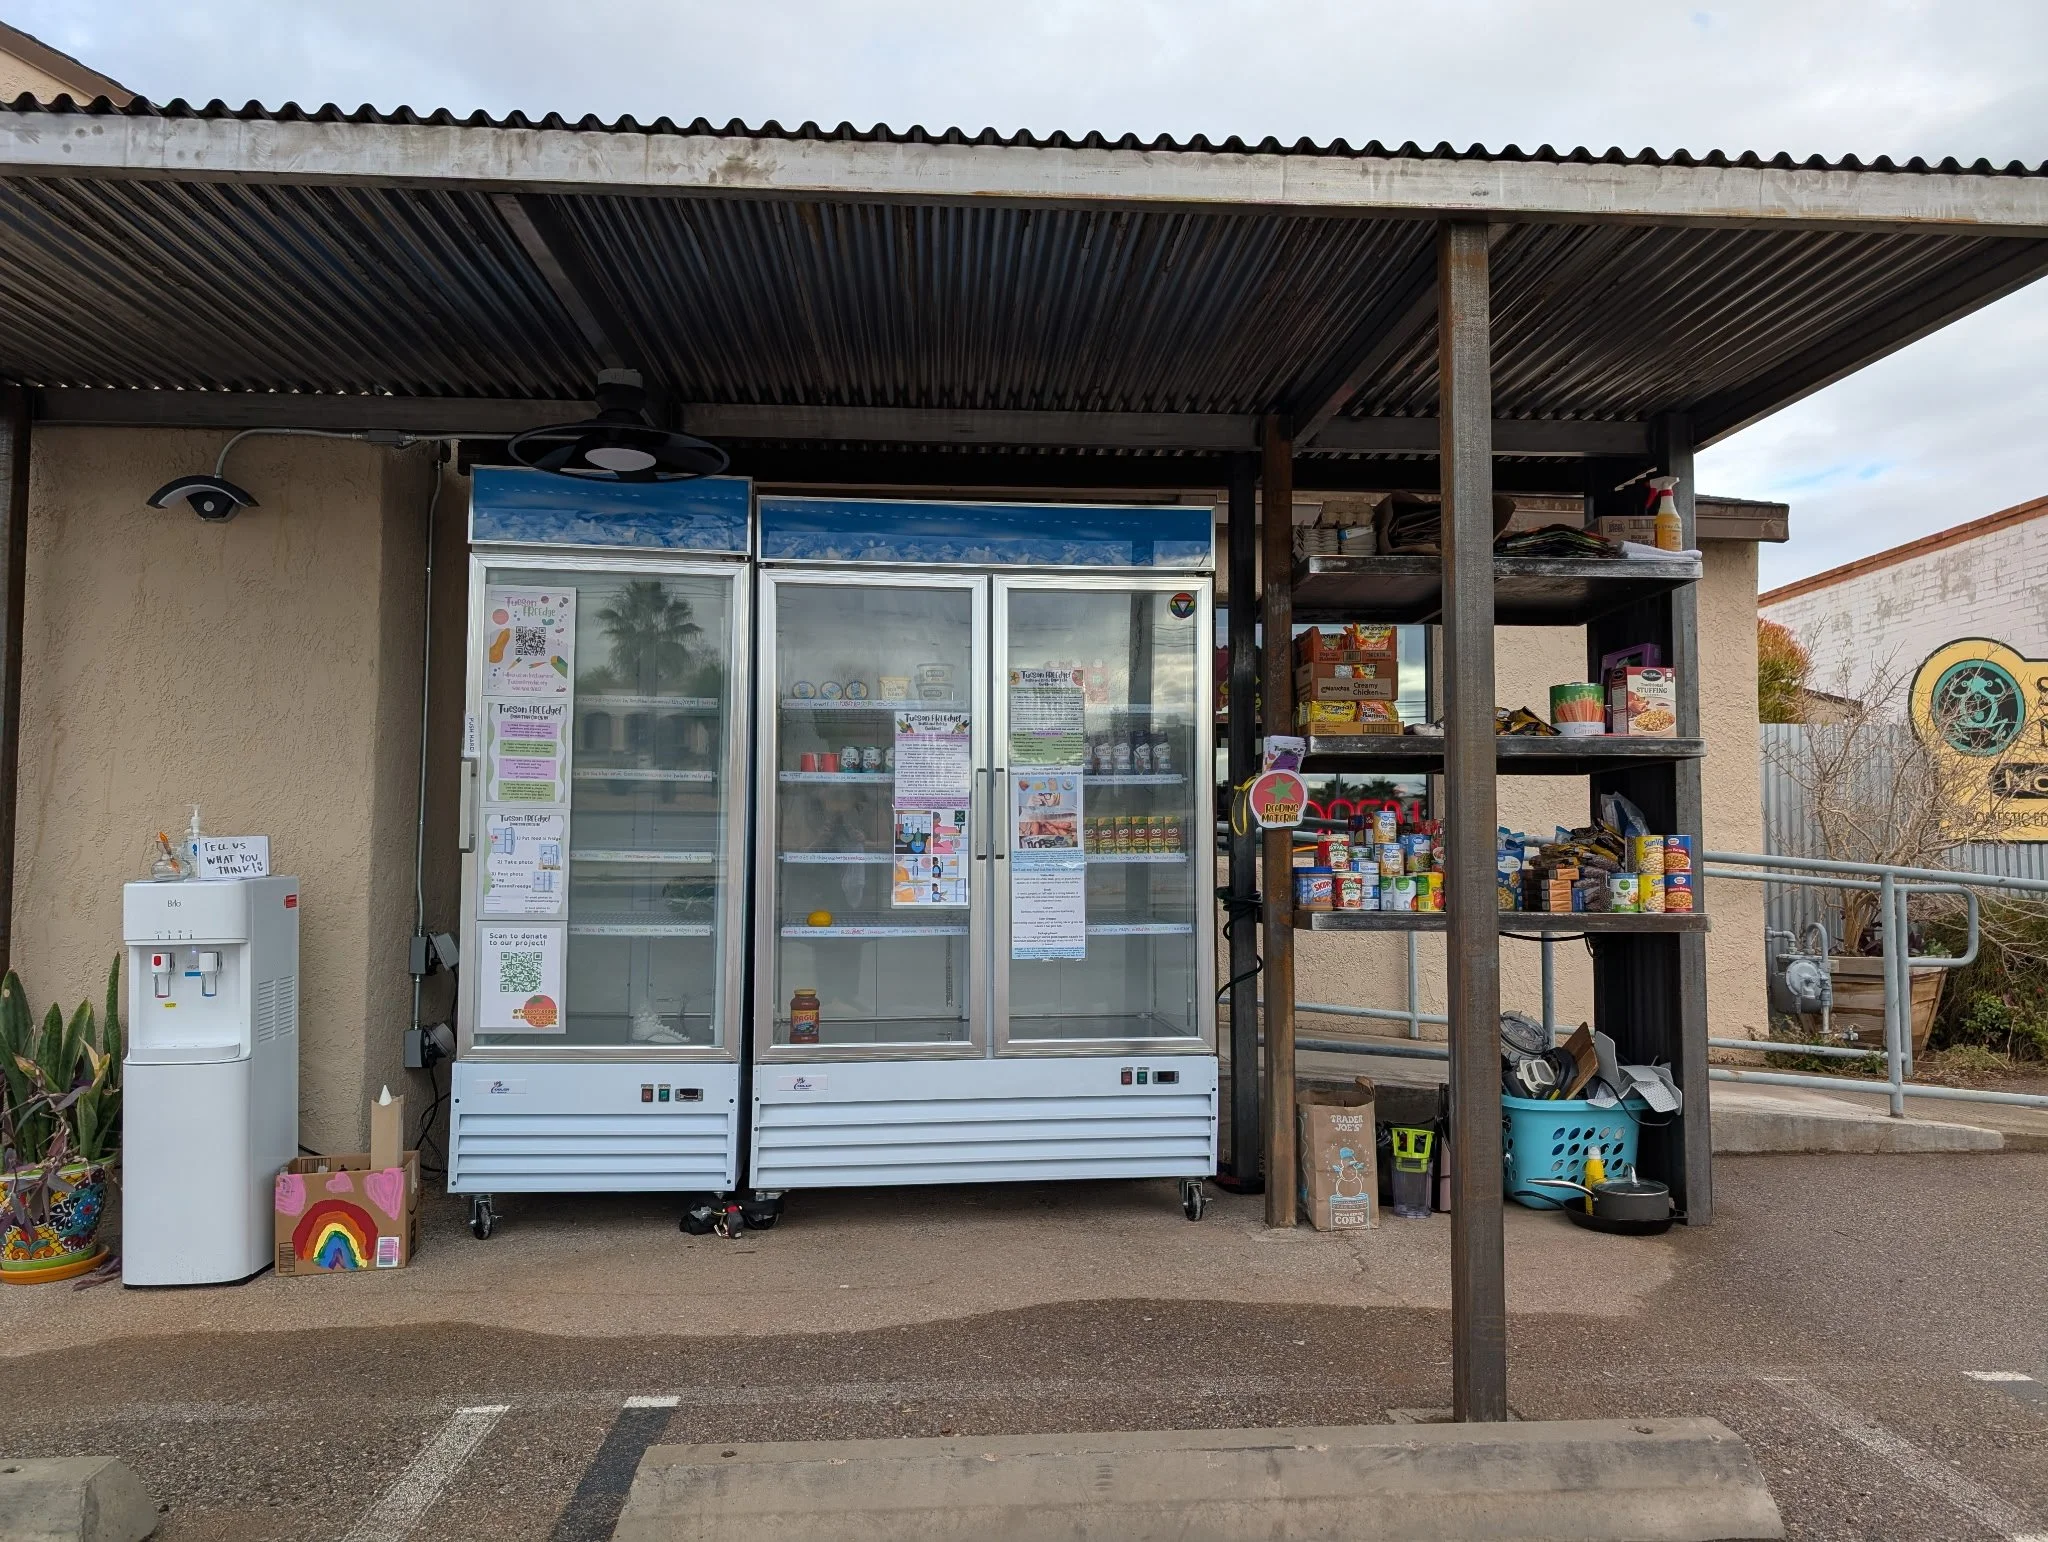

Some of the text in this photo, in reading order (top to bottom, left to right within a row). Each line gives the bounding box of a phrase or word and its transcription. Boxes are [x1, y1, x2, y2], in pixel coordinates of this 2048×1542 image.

[504, 596, 538, 608] Tucson
[1020, 670, 1044, 679] Tucson
[498, 704, 528, 714] Tucson
[904, 713, 930, 722] Tucson
[1265, 803, 1299, 813] READING
[1261, 814, 1299, 823] MATERIAL
[204, 842, 246, 852] TELL US
[206, 854, 258, 864] WHAT YOU
[1330, 1115, 1363, 1123] TRADER
[1335, 1123, 1362, 1132] JOE'S
[1335, 1215, 1364, 1224] CORN
